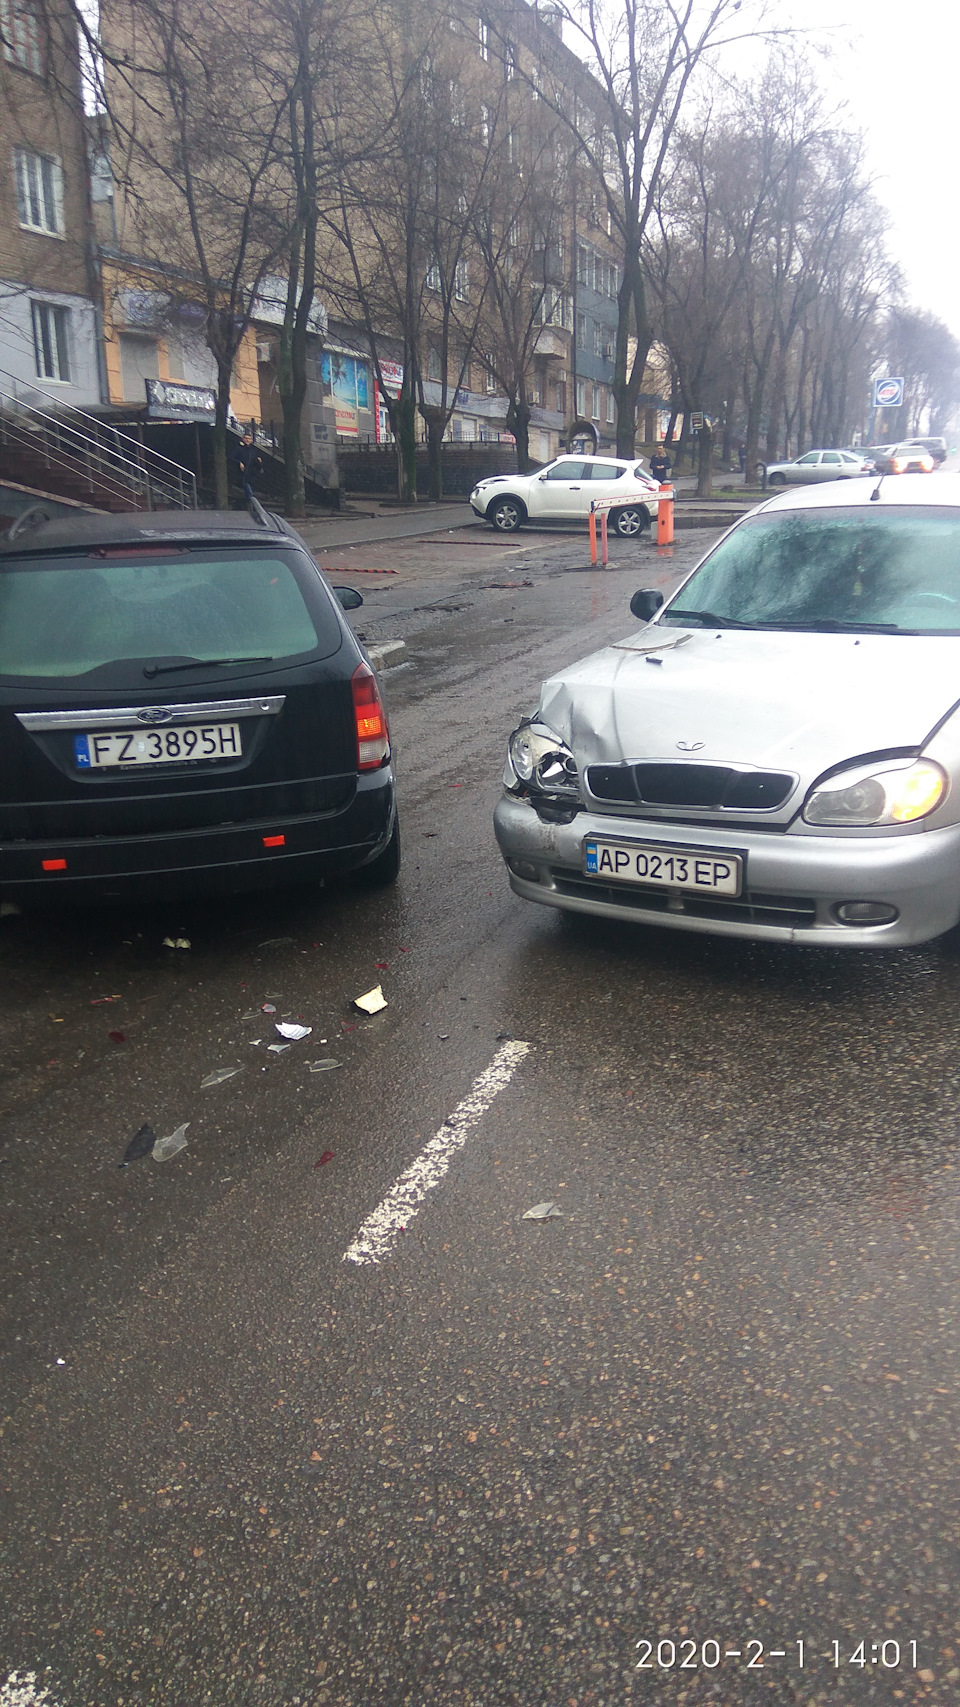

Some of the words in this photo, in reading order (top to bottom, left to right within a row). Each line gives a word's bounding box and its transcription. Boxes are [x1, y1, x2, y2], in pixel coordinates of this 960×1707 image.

[93, 734, 137, 763] FZ
[146, 726, 237, 759] 3895H
[77, 754, 89, 763] PL
[586, 861, 598, 870] UA
[599, 849, 630, 873] AP
[636, 853, 688, 882] 0213
[695, 860, 731, 886] EP
